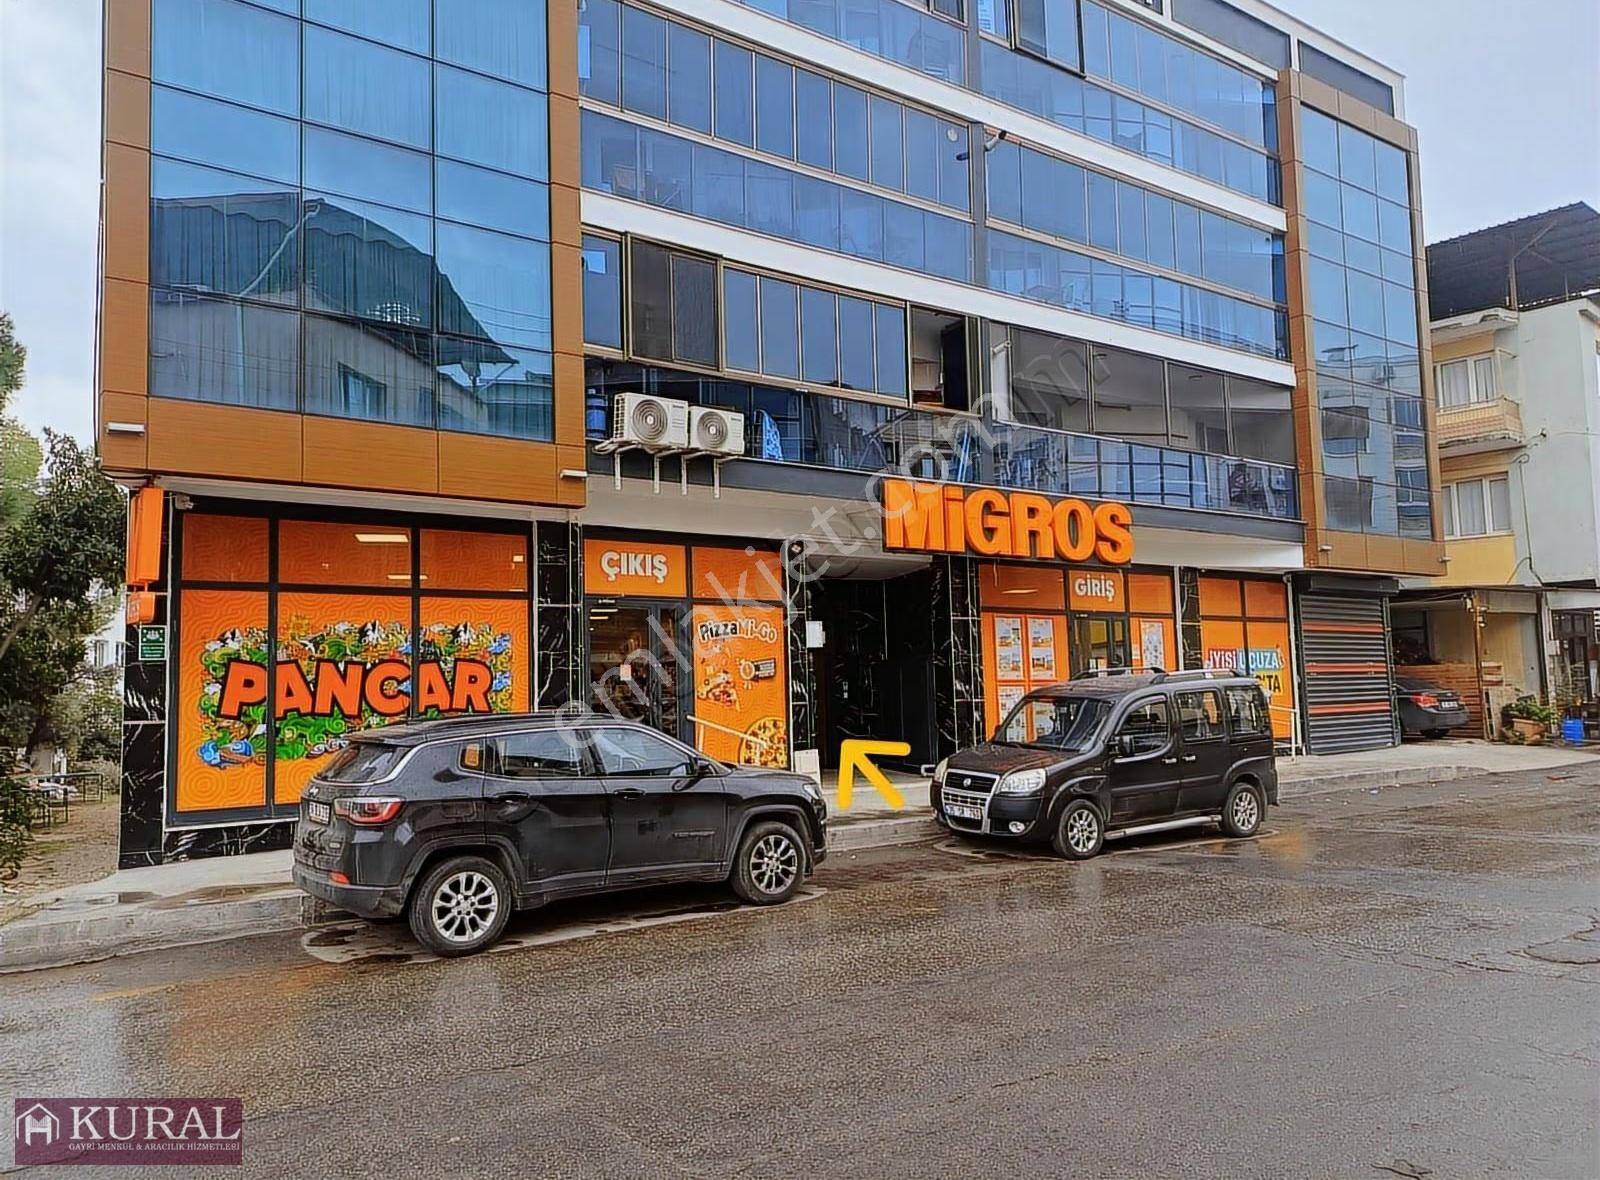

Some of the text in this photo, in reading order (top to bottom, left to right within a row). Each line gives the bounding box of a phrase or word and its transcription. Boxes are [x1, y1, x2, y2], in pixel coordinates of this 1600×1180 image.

[600, 551, 669, 583] ÇIKIŞ
[1074, 575, 1115, 602] GİRİŞ
[218, 658, 494, 720] PANCAR
